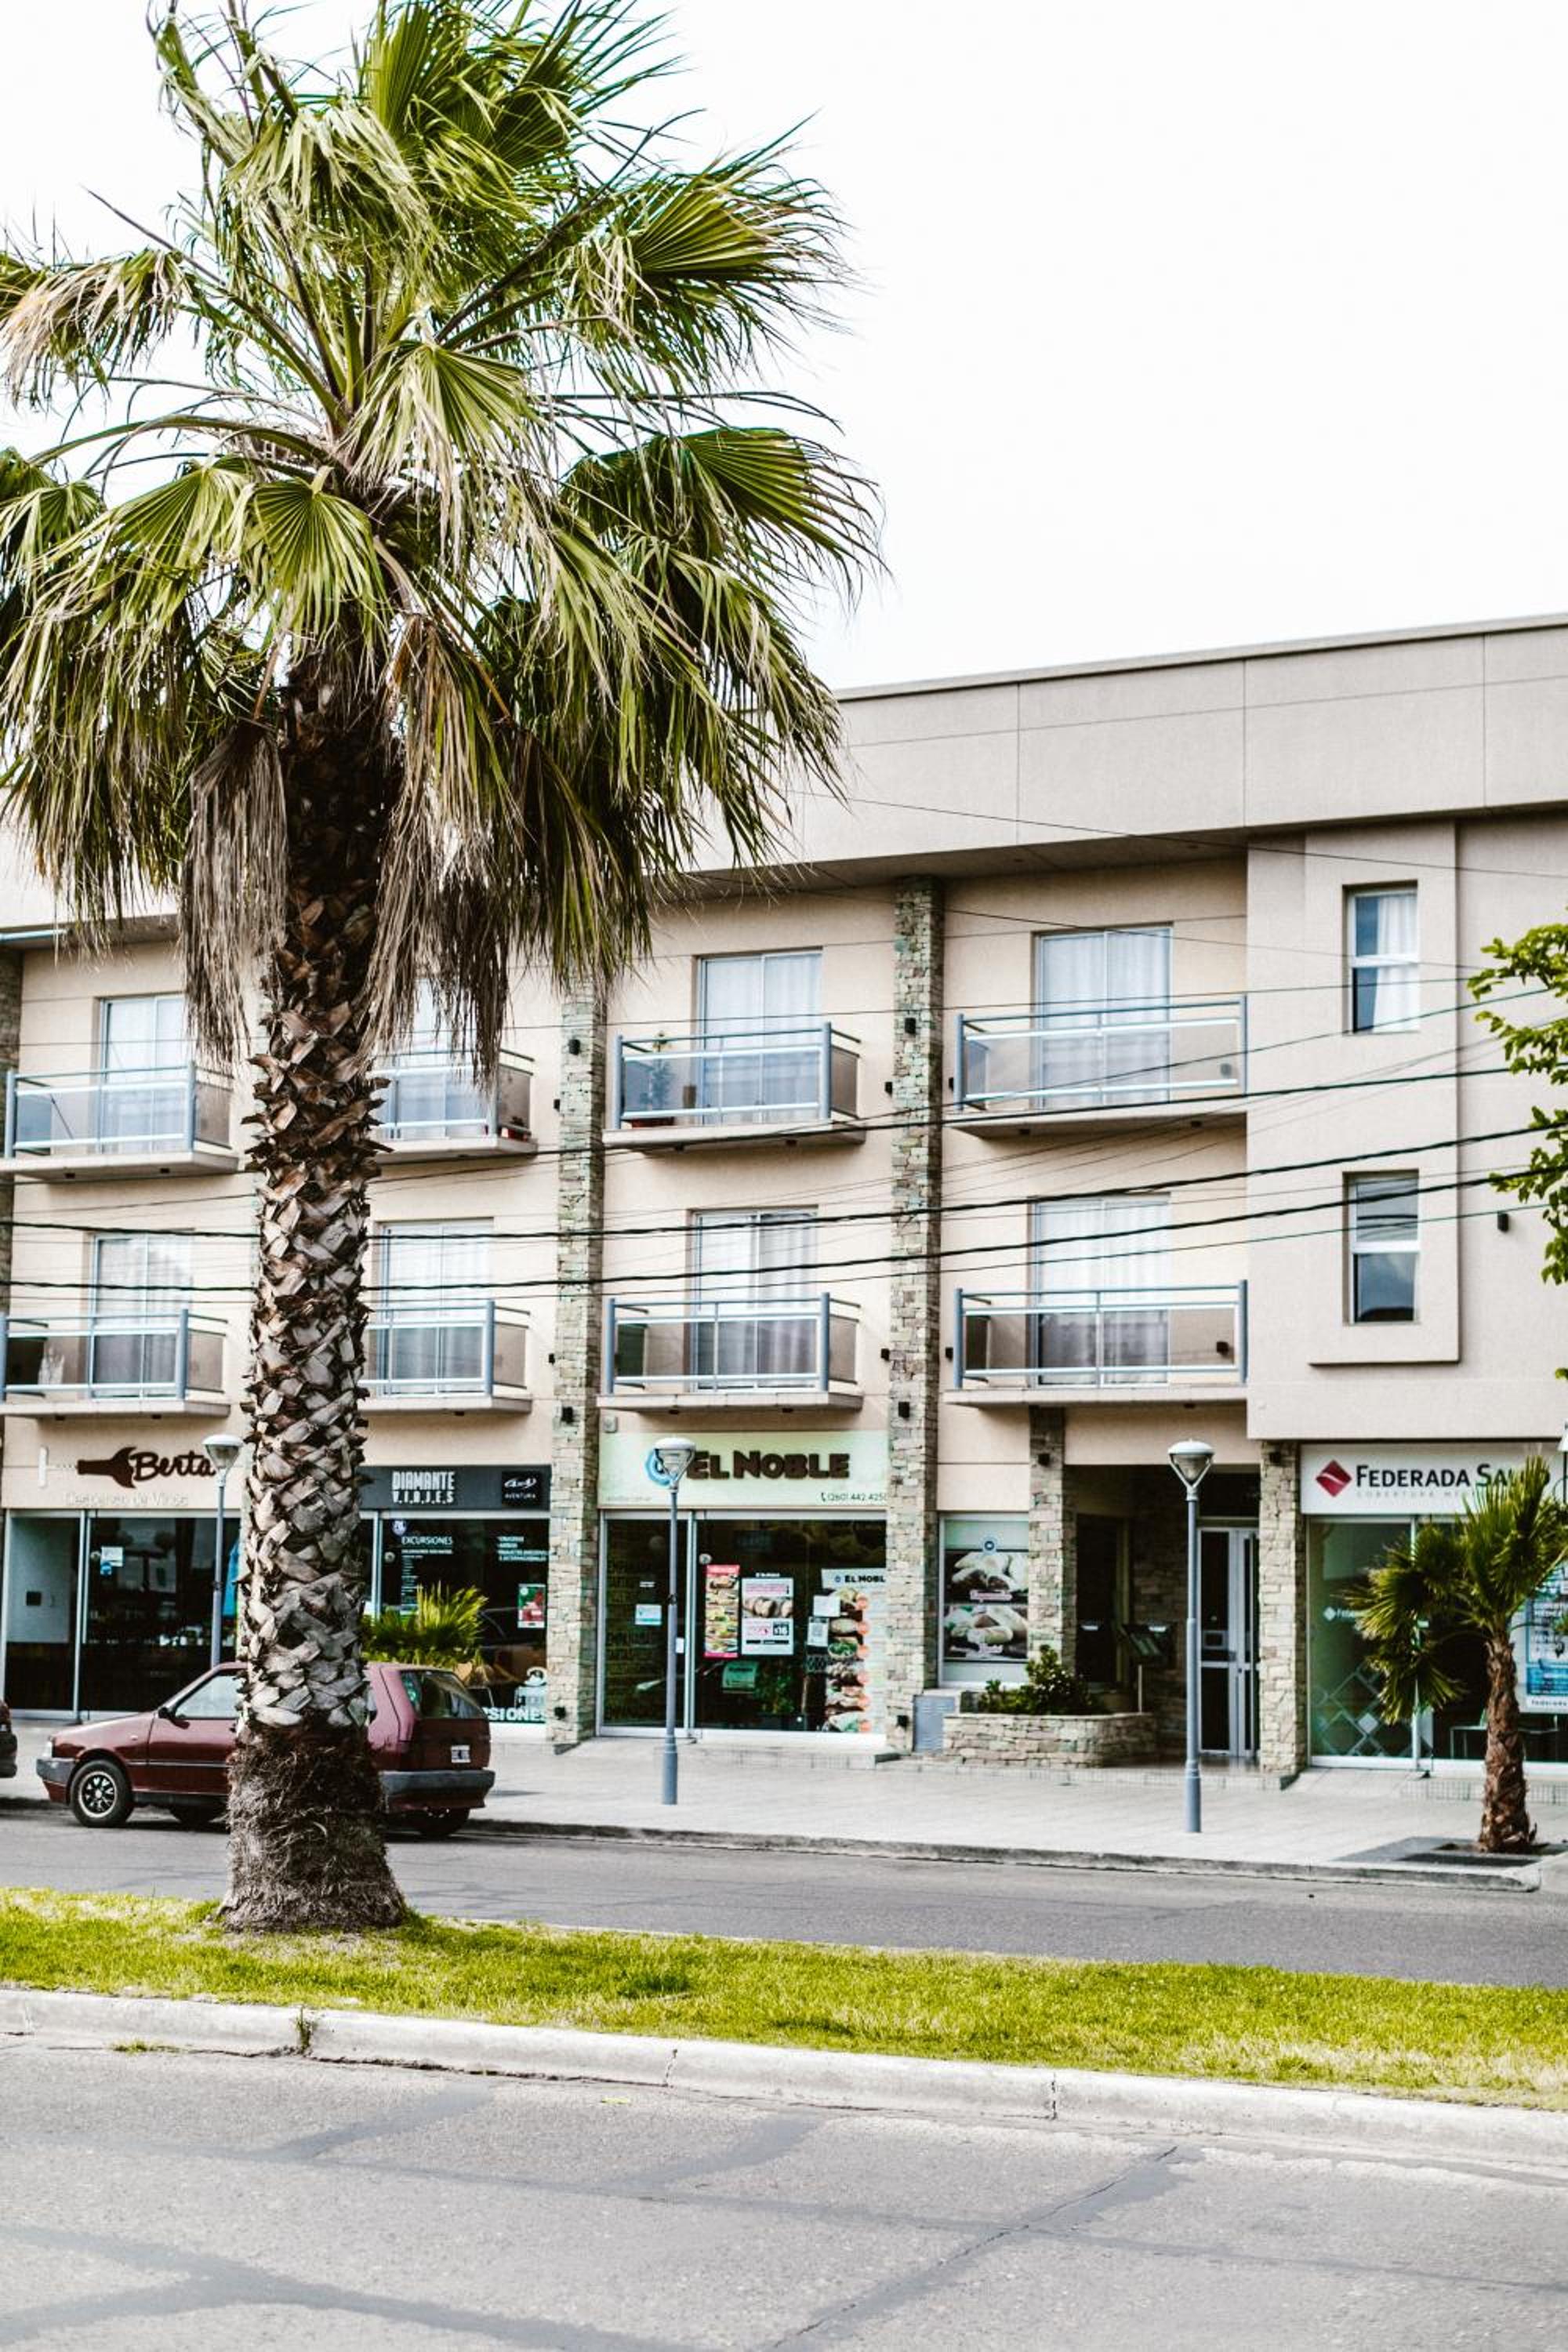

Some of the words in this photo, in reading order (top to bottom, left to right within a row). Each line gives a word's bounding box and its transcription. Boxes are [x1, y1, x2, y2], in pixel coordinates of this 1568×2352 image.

[128, 1450, 216, 1482] Berta
[687, 1450, 730, 1479] EL
[733, 1450, 850, 1479] NOBLE
[393, 1471, 455, 1490] DIAMANTE
[1356, 1465, 1470, 1487] FEDERADA
[401, 1536, 453, 1544] EXCURSIONES
